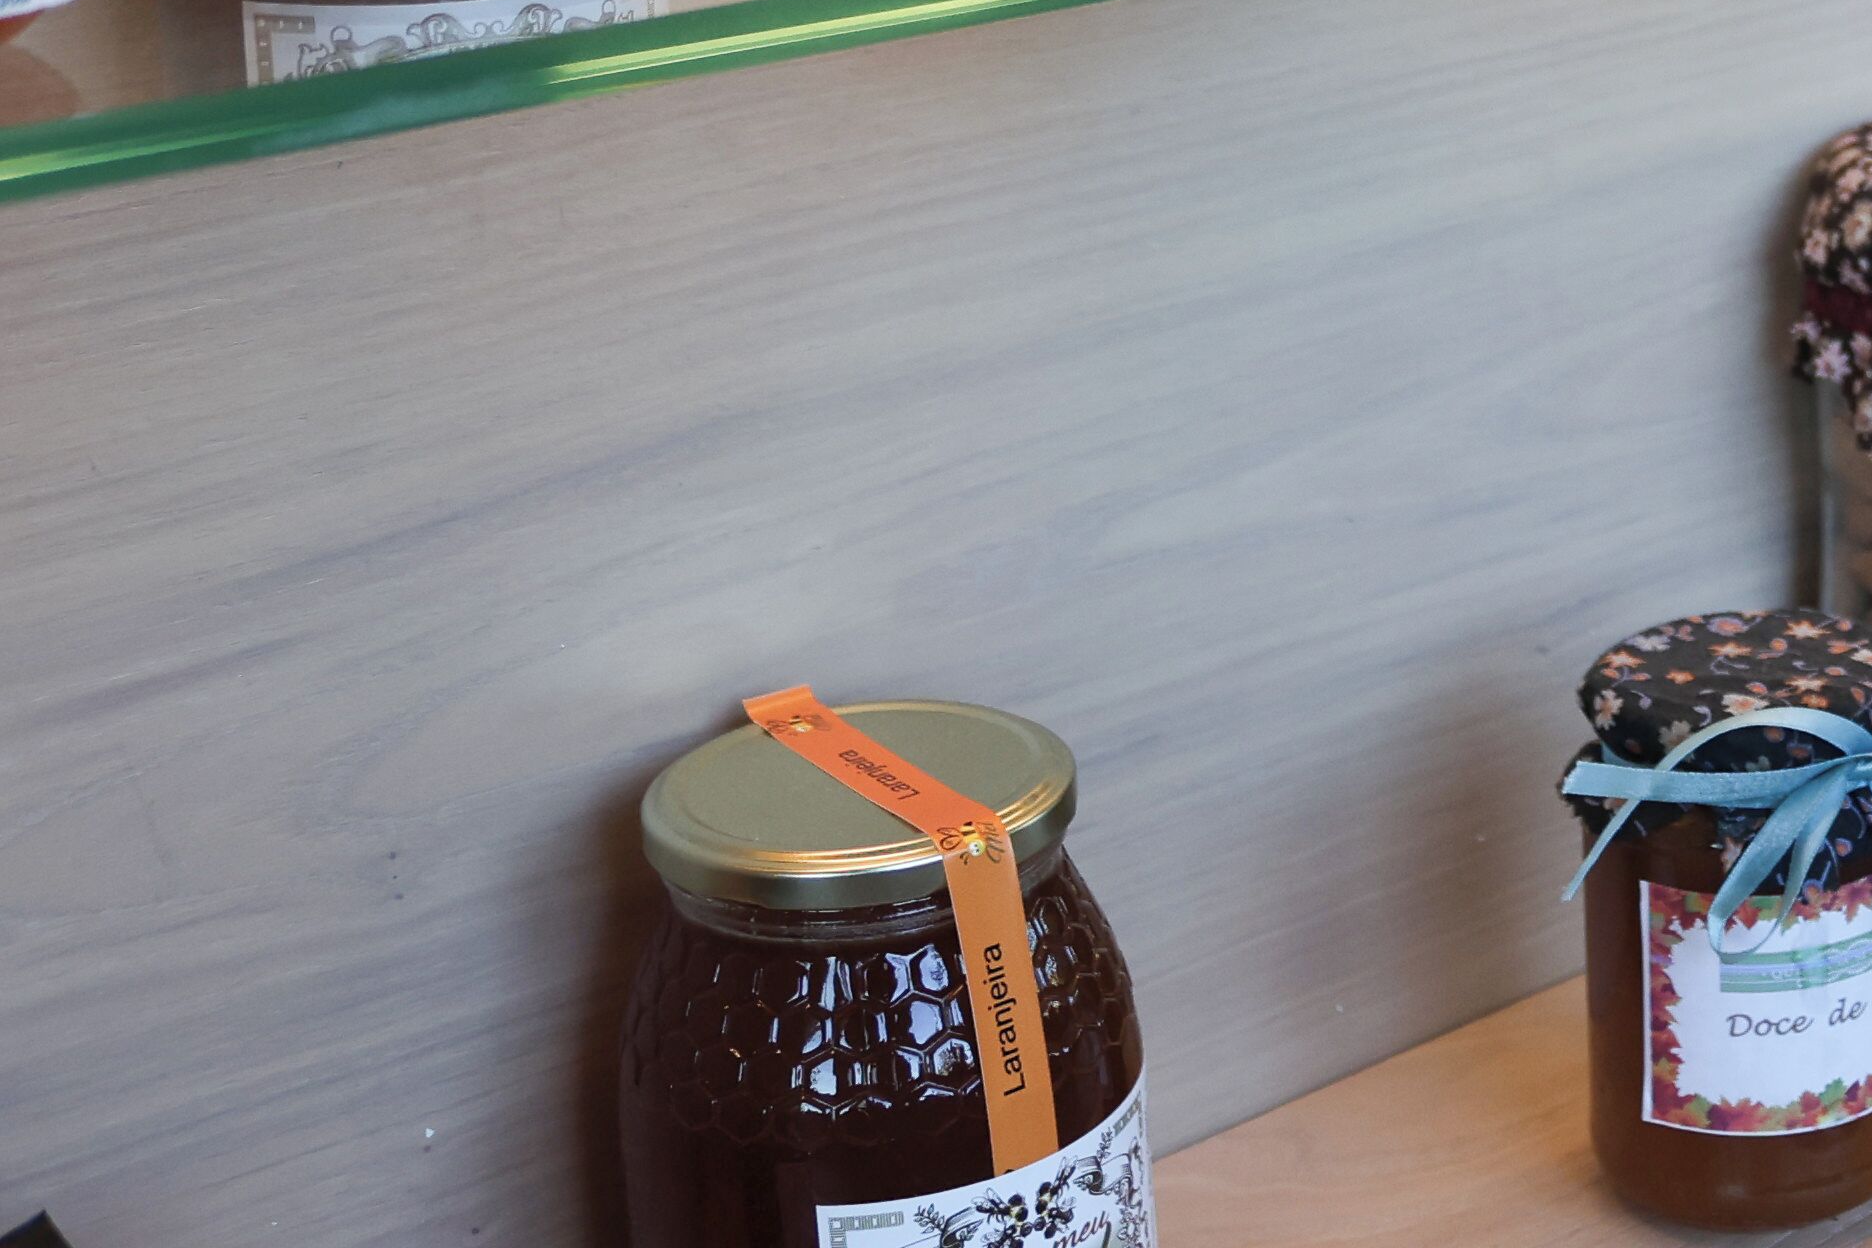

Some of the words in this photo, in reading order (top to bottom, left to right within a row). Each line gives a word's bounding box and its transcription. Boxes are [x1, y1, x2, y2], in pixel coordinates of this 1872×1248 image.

[838, 749, 920, 800] Laranjeira
[983, 942, 1028, 1097] Laranjeira
[1726, 1013, 1815, 1038] Doce
[1828, 997, 1868, 1027] de
[1053, 1210, 1109, 1248] meu
